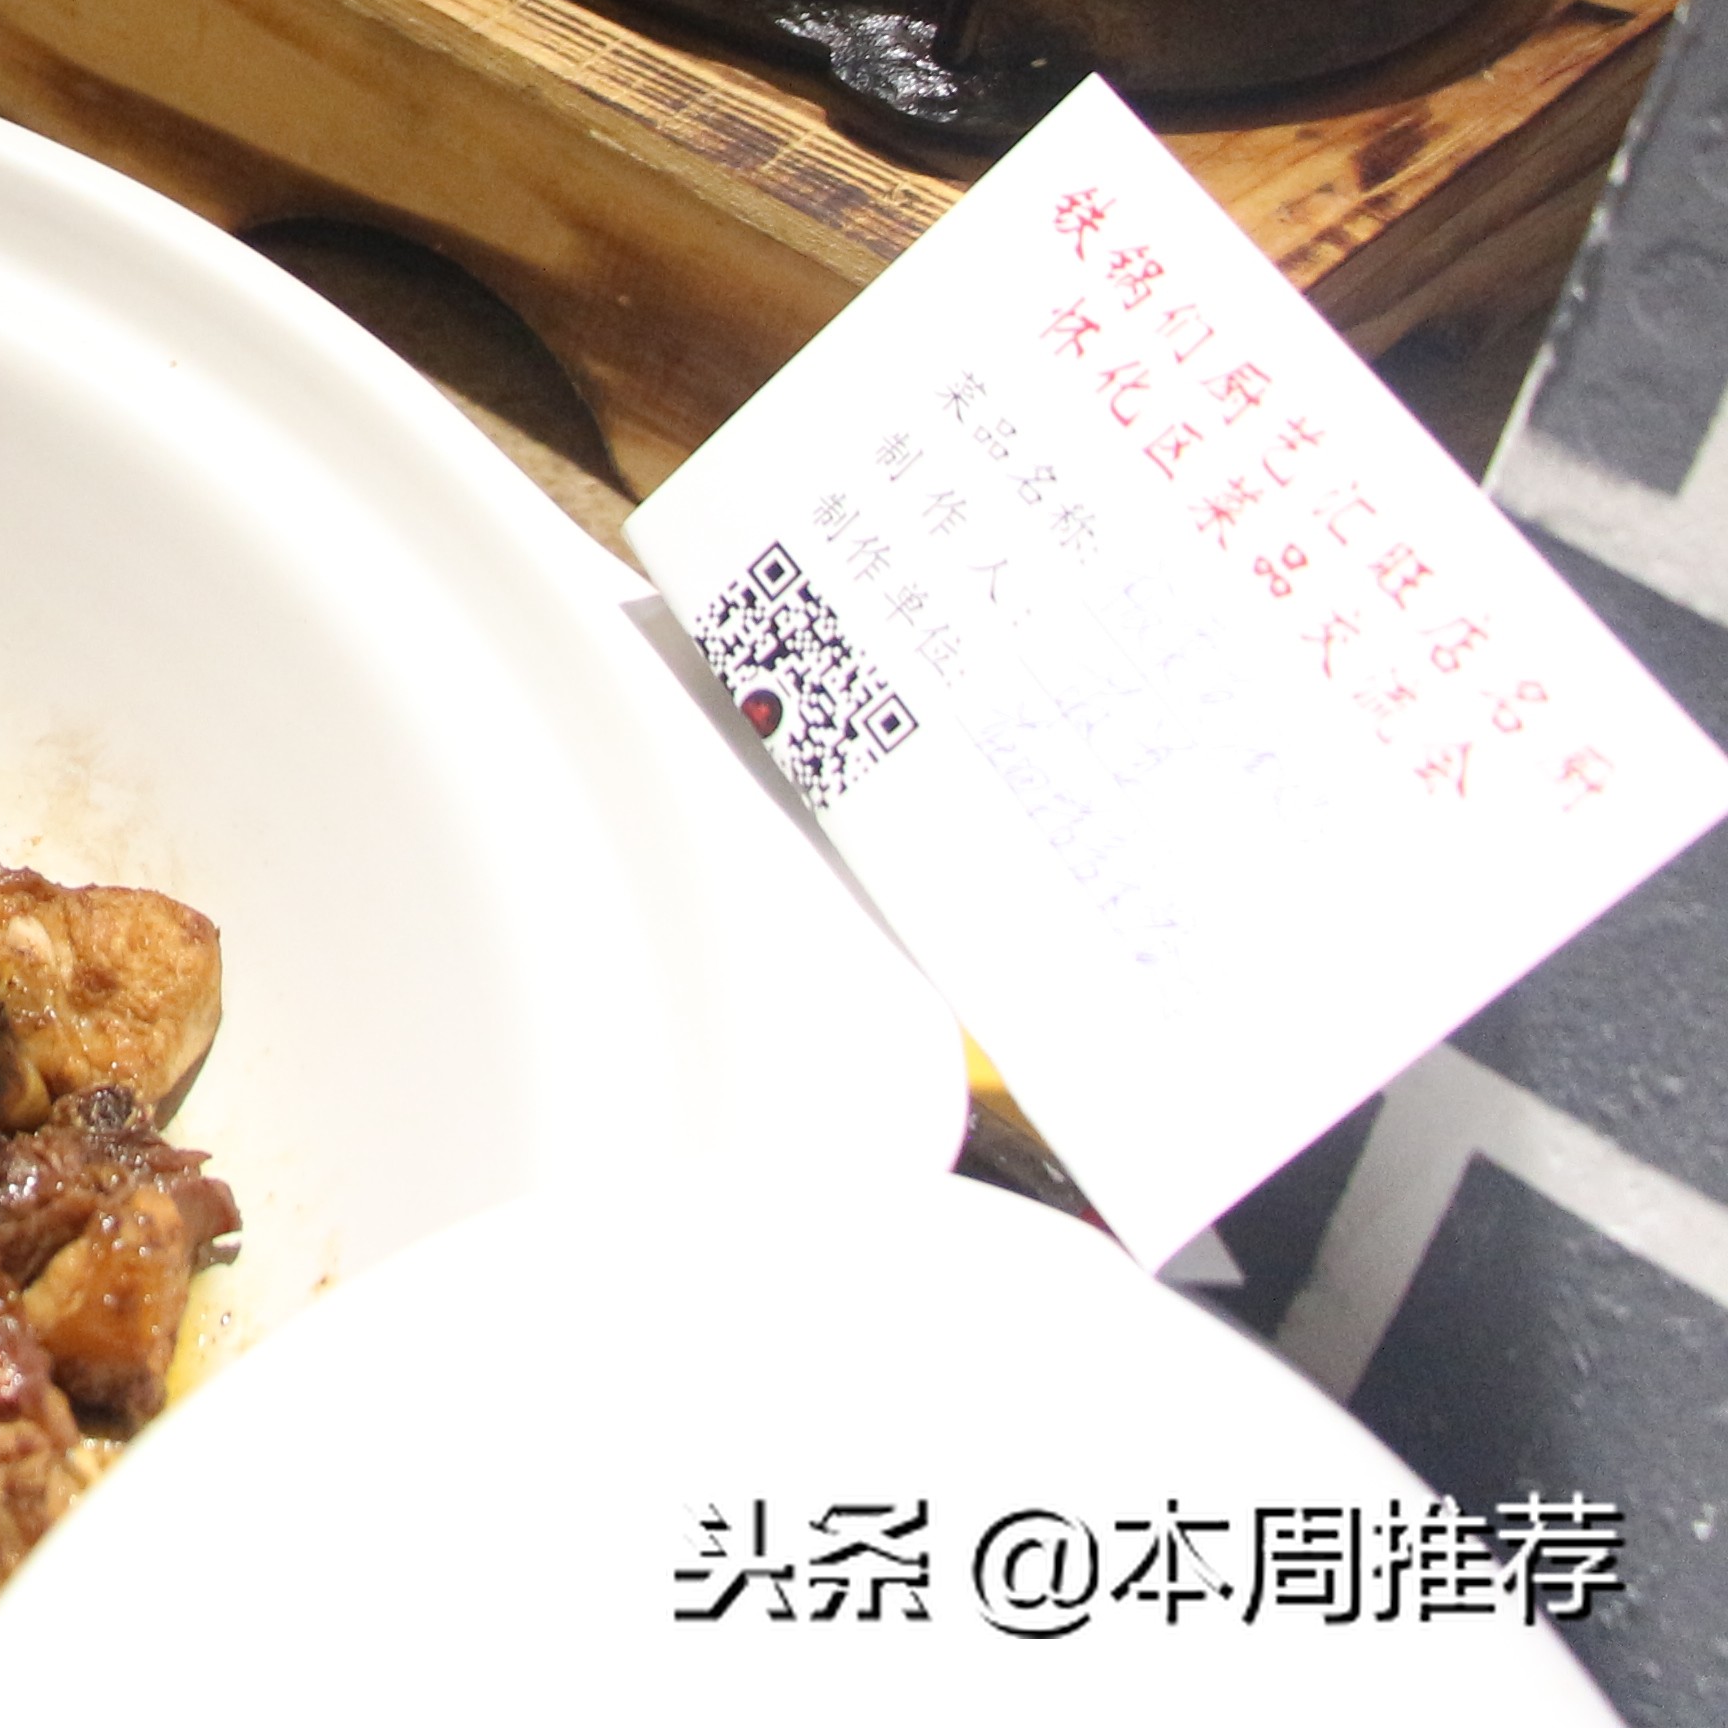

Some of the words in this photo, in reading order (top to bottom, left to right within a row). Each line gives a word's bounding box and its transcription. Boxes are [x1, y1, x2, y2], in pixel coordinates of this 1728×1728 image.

[1039, 295, 1475, 800] 怀化区菜品交流会
[1051, 183, 1614, 815] 铁锅们厨艺汇旺店名厨
